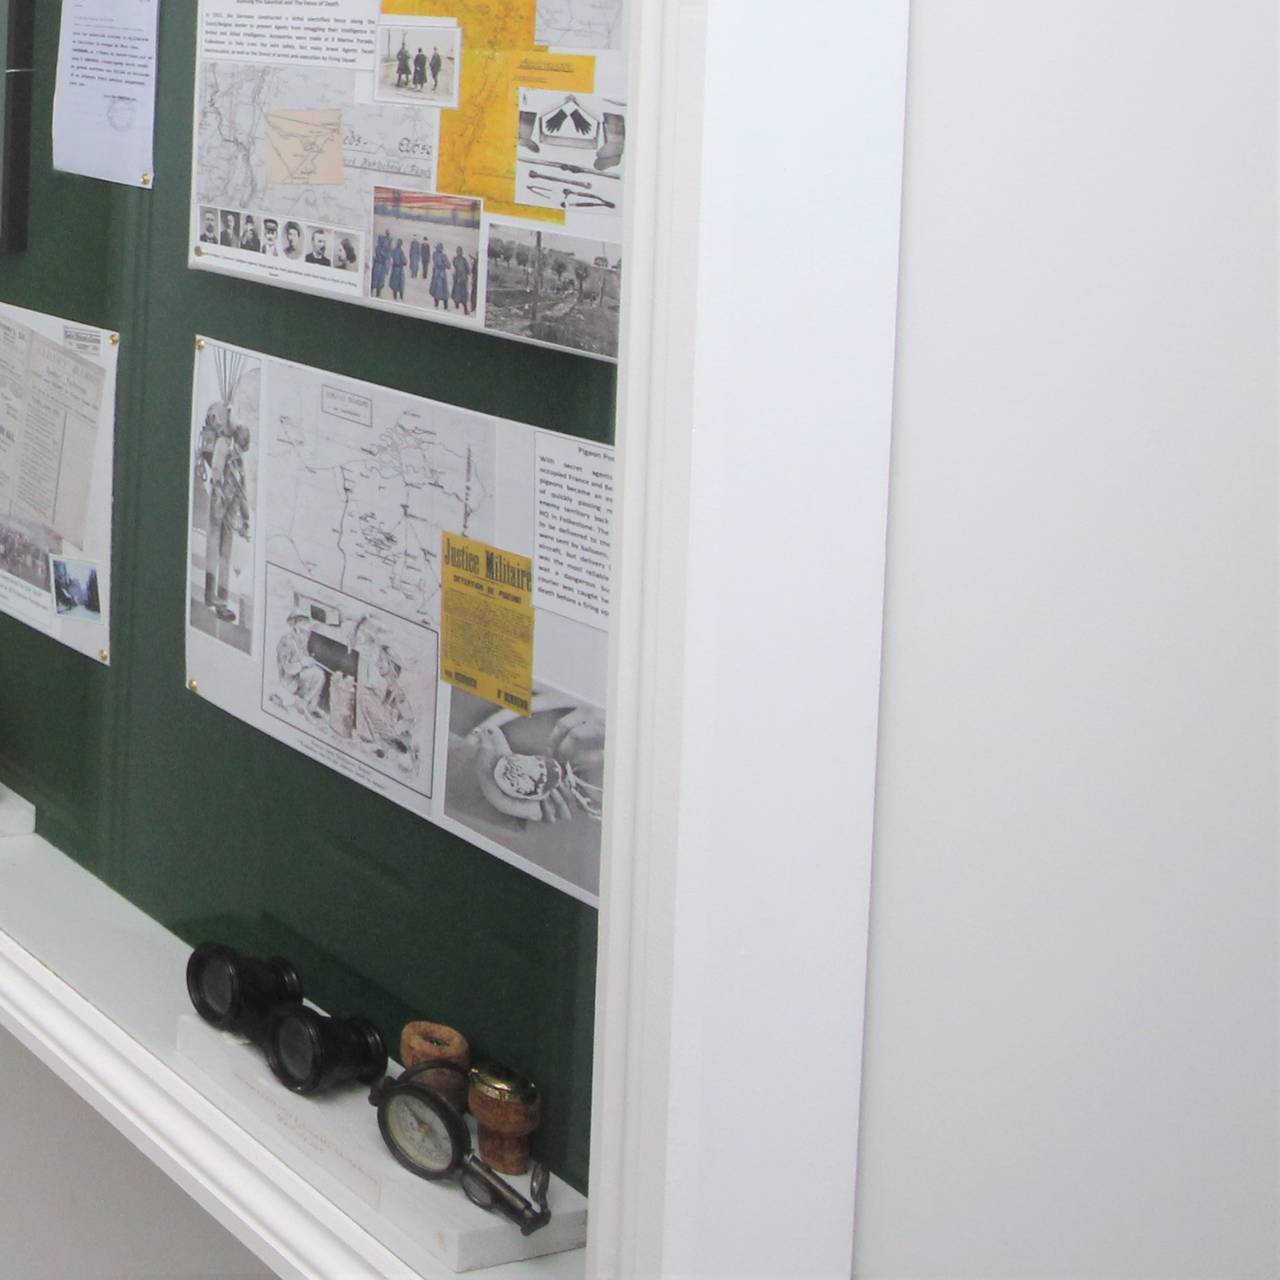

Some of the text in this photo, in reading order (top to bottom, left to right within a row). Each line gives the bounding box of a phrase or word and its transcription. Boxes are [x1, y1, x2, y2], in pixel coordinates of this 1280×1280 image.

[578, 447, 601, 458] Pigeon
[539, 456, 554, 464] With
[563, 462, 582, 472] secret
[539, 467, 566, 479] occupied
[568, 475, 589, 485] France
[539, 478, 562, 489] pigeons
[566, 486, 590, 496] became
[550, 492, 572, 503] quickly
[563, 507, 589, 519] territory
[558, 527, 587, 540] delivered
[445, 537, 532, 593] Justice Militaire
